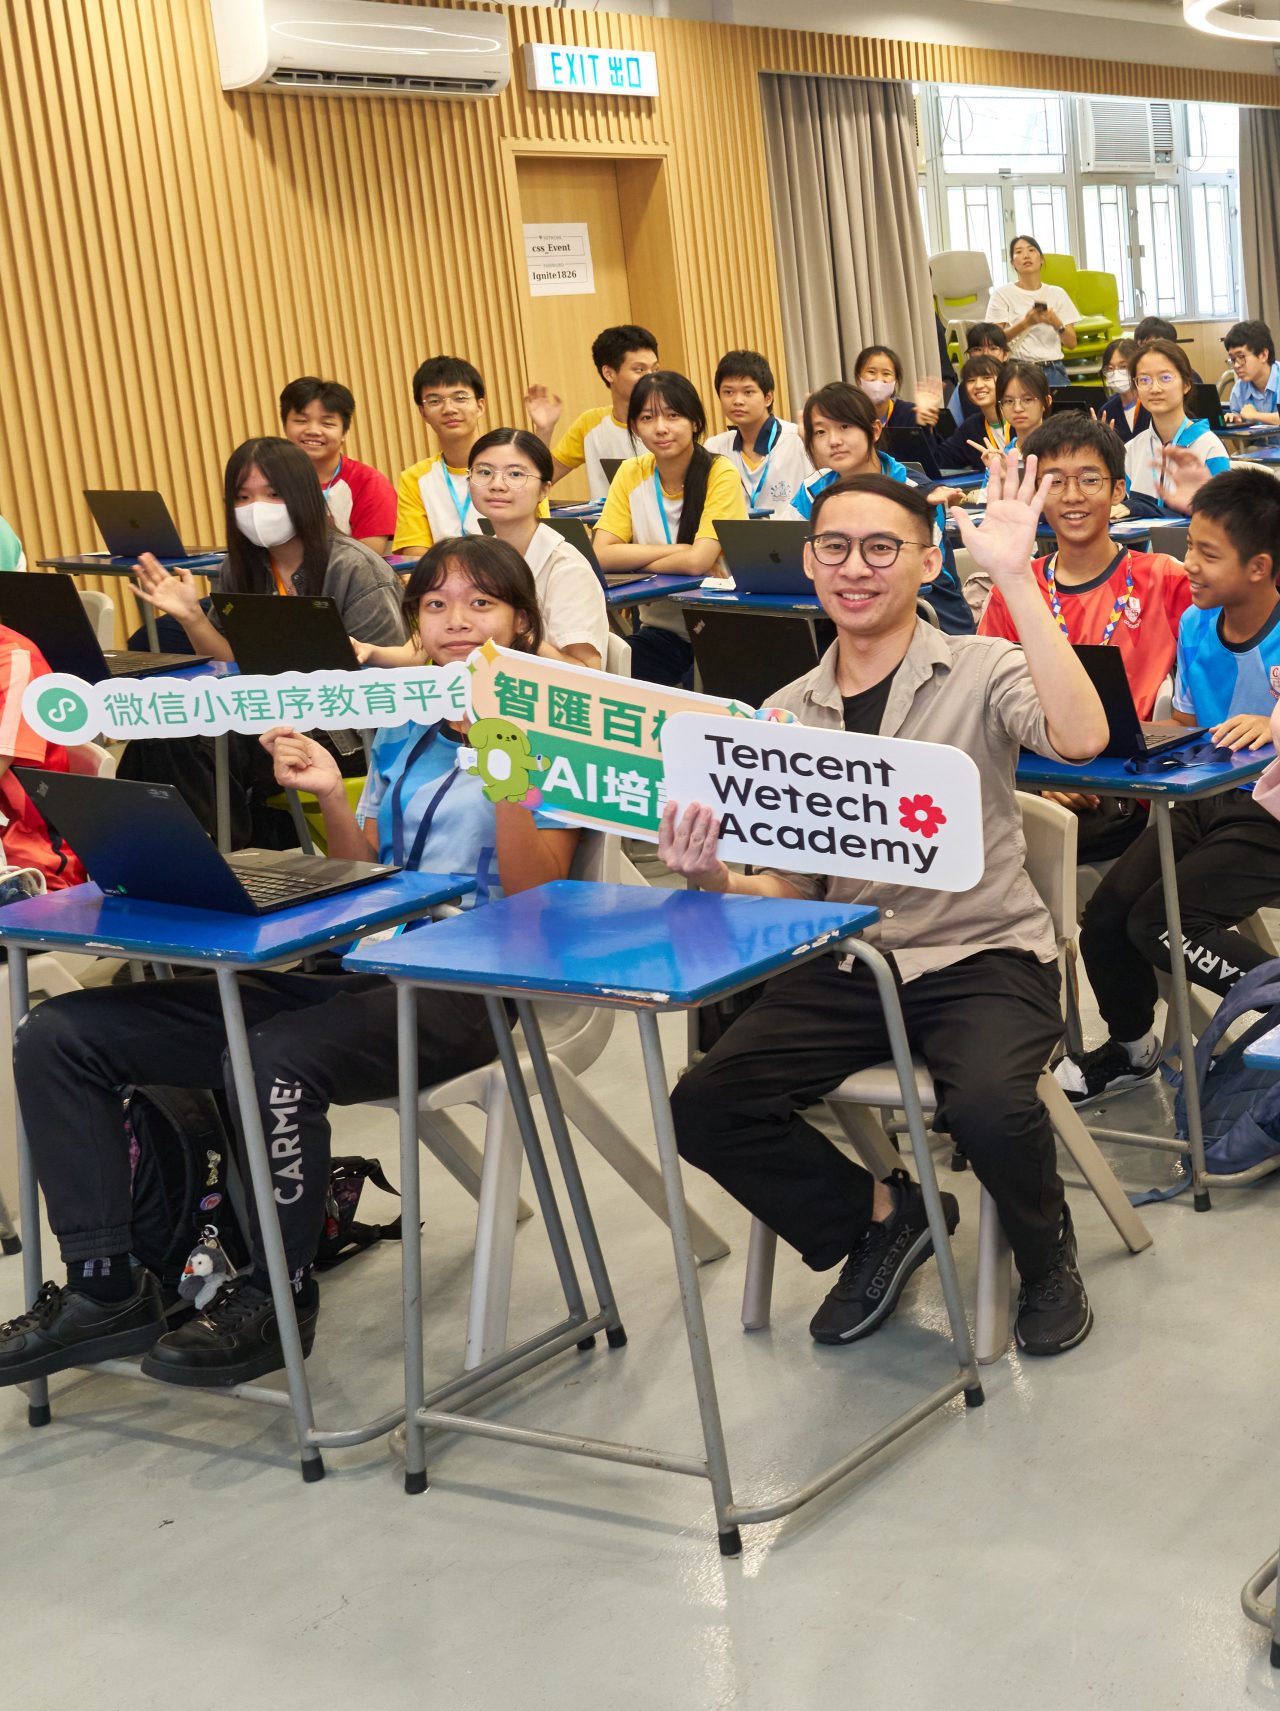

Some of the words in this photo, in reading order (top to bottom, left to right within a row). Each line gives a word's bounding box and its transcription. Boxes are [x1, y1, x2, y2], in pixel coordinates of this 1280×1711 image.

[551, 52, 599, 86] EXIT
[608, 56, 641, 88] 出口
[532, 270, 577, 281] Ignite1826
[704, 734, 897, 787] Tencent
[709, 773, 888, 825] Wetech
[717, 812, 939, 874] Academy
